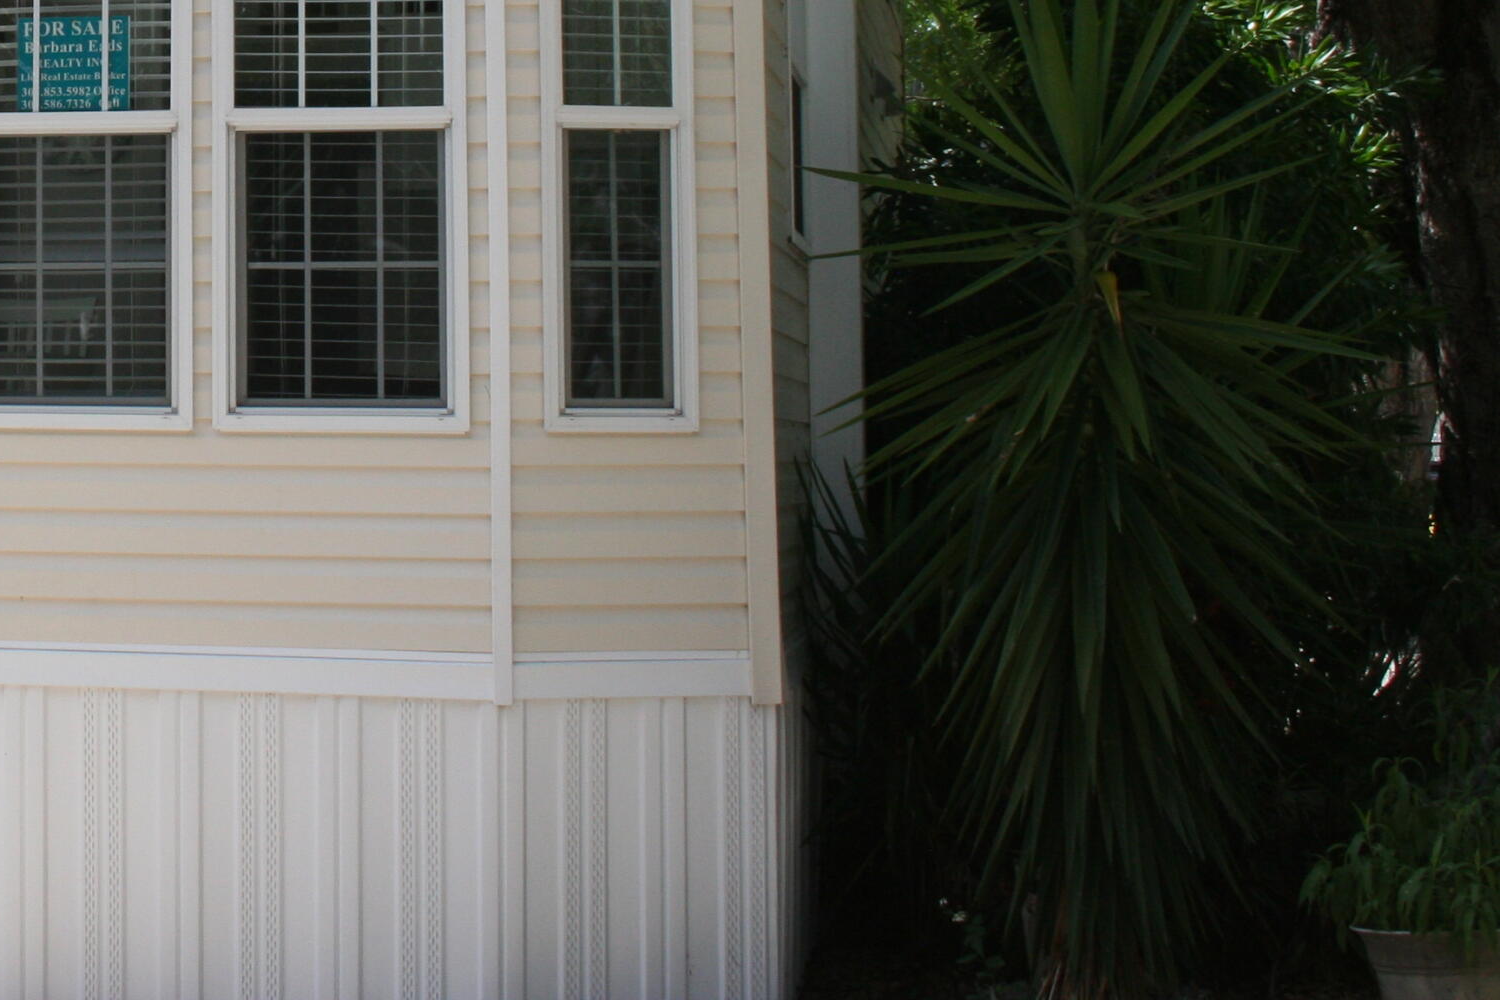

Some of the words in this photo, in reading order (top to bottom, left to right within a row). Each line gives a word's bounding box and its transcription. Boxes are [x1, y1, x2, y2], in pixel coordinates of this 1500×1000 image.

[23, 20, 65, 37] FOR
[25, 41, 83, 53] Brbara
[87, 58, 112, 67] IN.
[41, 73, 60, 81] Real
[64, 73, 93, 81] Estate
[94, 71, 126, 80] Bker
[22, 86, 91, 97] 30.853.5982
[93, 85, 126, 96] Oice
[22, 98, 91, 110] 30.586.7326
